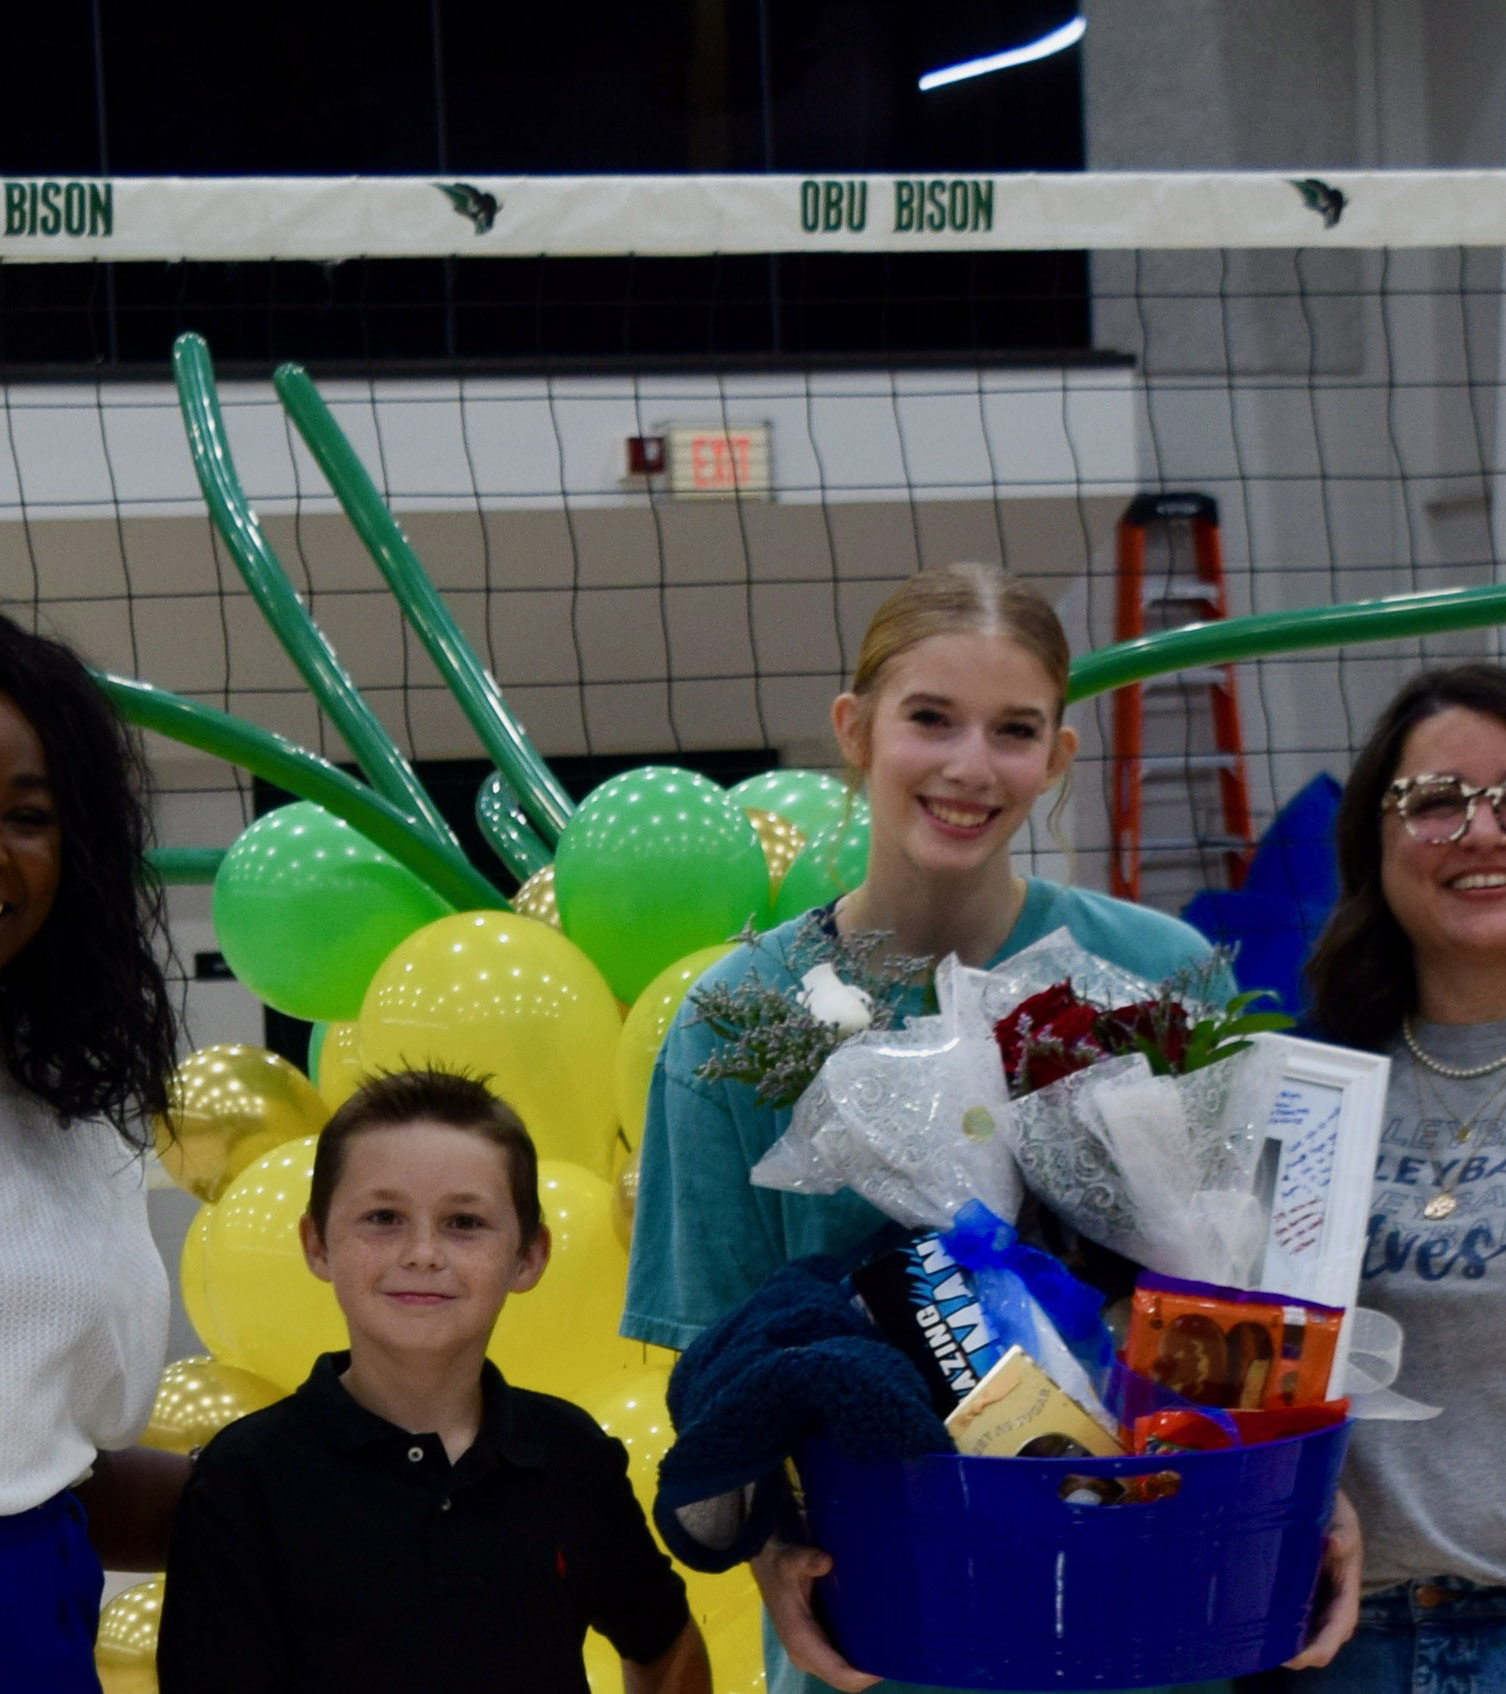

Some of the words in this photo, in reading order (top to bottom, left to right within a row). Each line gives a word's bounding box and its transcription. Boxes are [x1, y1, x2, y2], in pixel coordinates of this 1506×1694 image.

[4, 182, 113, 237] BISON
[801, 180, 867, 233] OBU
[893, 180, 994, 233] BISON
[691, 436, 750, 487] EXIT
[915, 1304, 978, 1398] AZING
